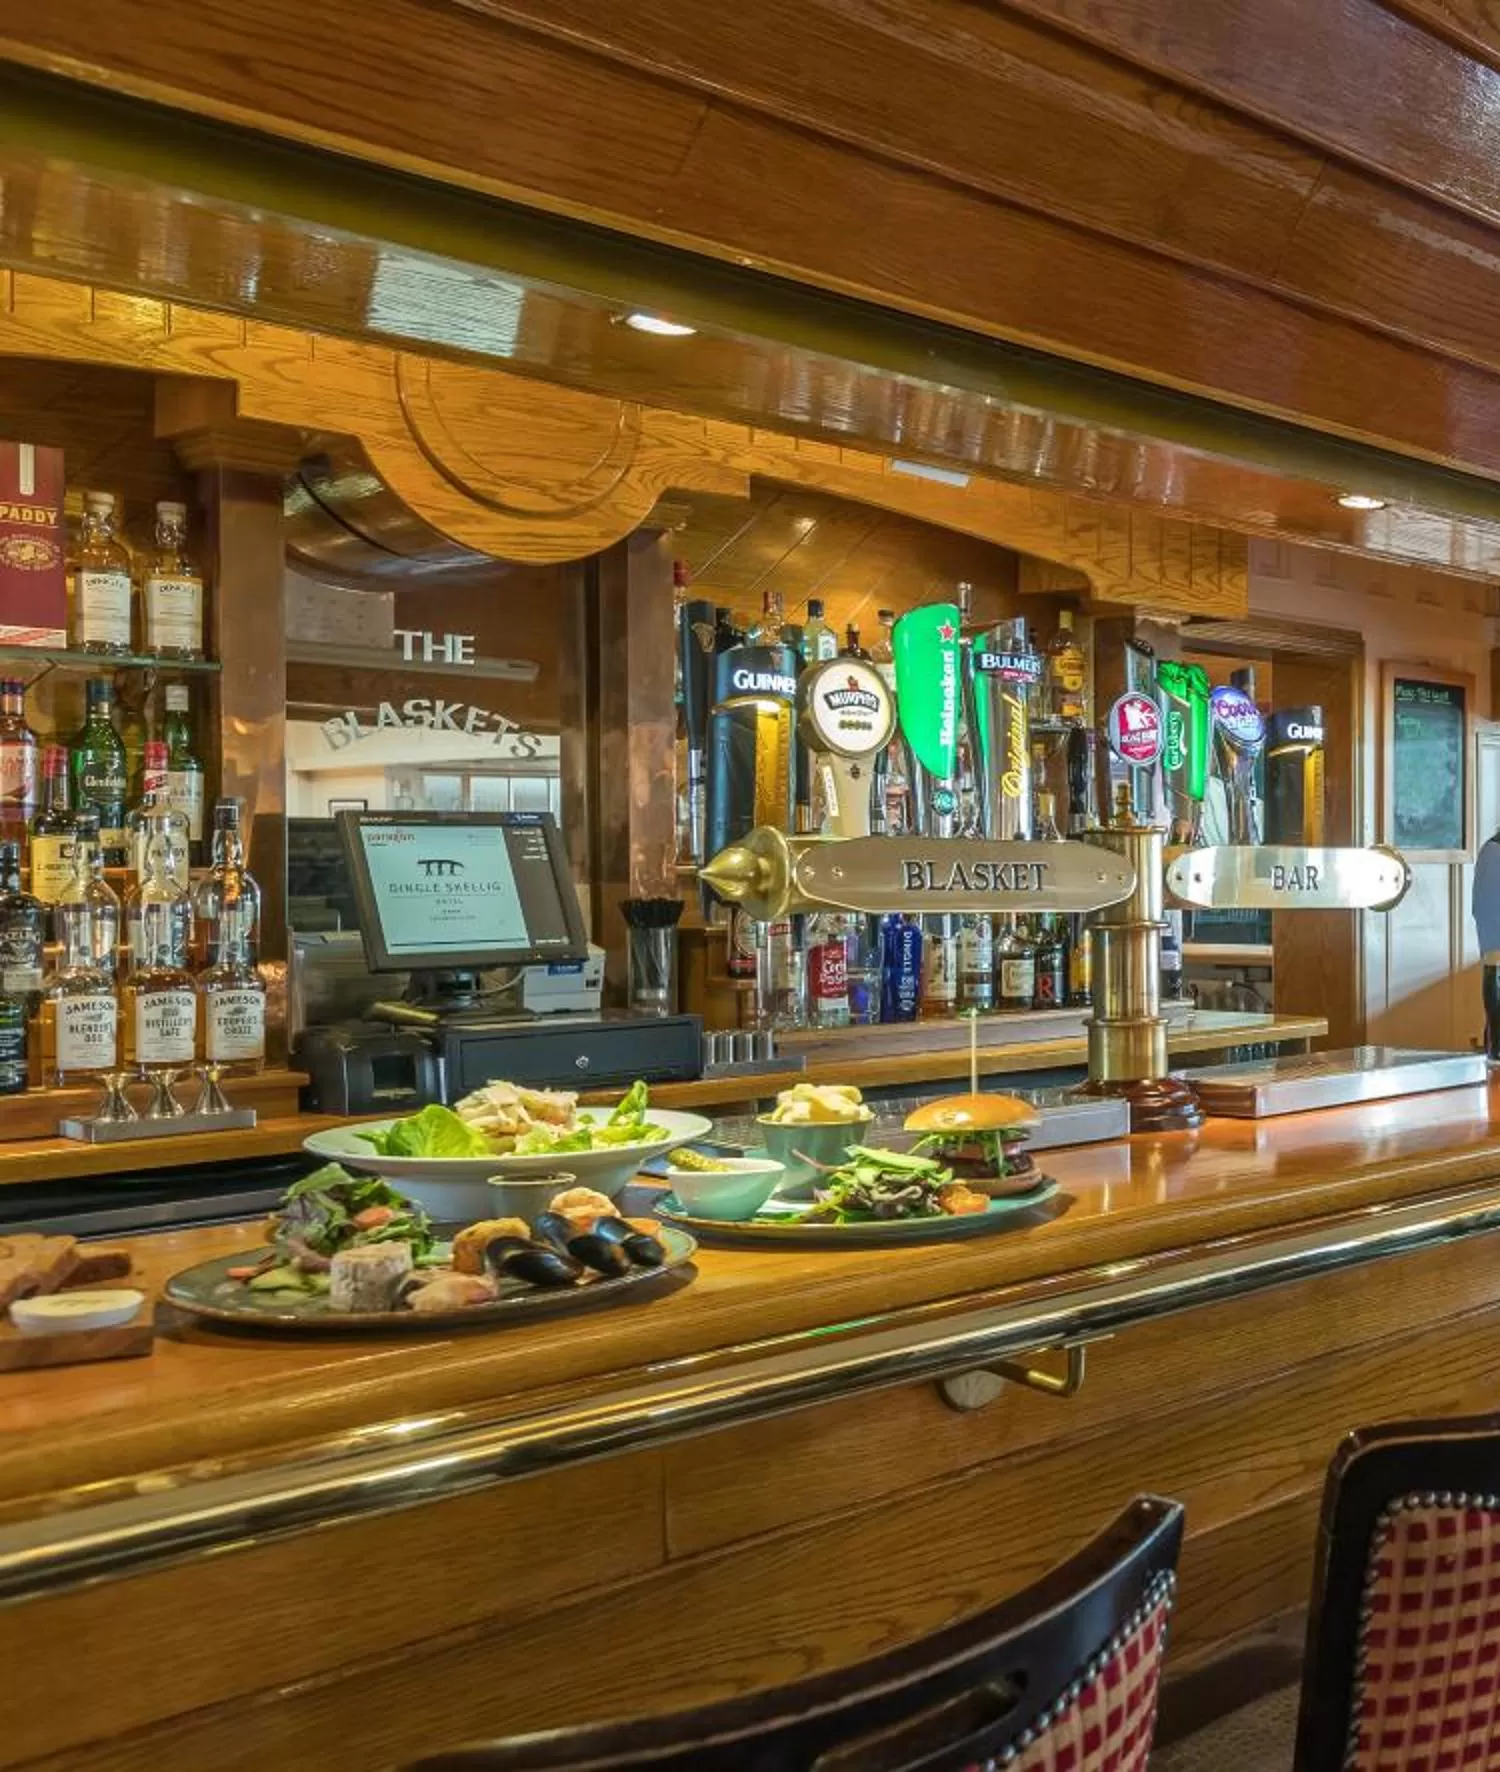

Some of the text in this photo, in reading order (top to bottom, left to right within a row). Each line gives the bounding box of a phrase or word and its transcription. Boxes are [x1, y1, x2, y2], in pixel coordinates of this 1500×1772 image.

[0, 506, 57, 525] PADDY
[393, 629, 476, 665] THE
[939, 651, 956, 746] Heineken
[320, 699, 543, 760] BLASKETS
[1166, 711, 1184, 771] Carlsberg
[1001, 692, 1029, 798] Original
[388, 881, 502, 894] DINGLE SKELLIG
[901, 859, 1049, 892] BLASKET
[1270, 864, 1320, 892] BAR
[65, 1001, 115, 1015] JAMESON
[143, 995, 193, 1010] JAMESON
[213, 994, 262, 1008] JAMESON
